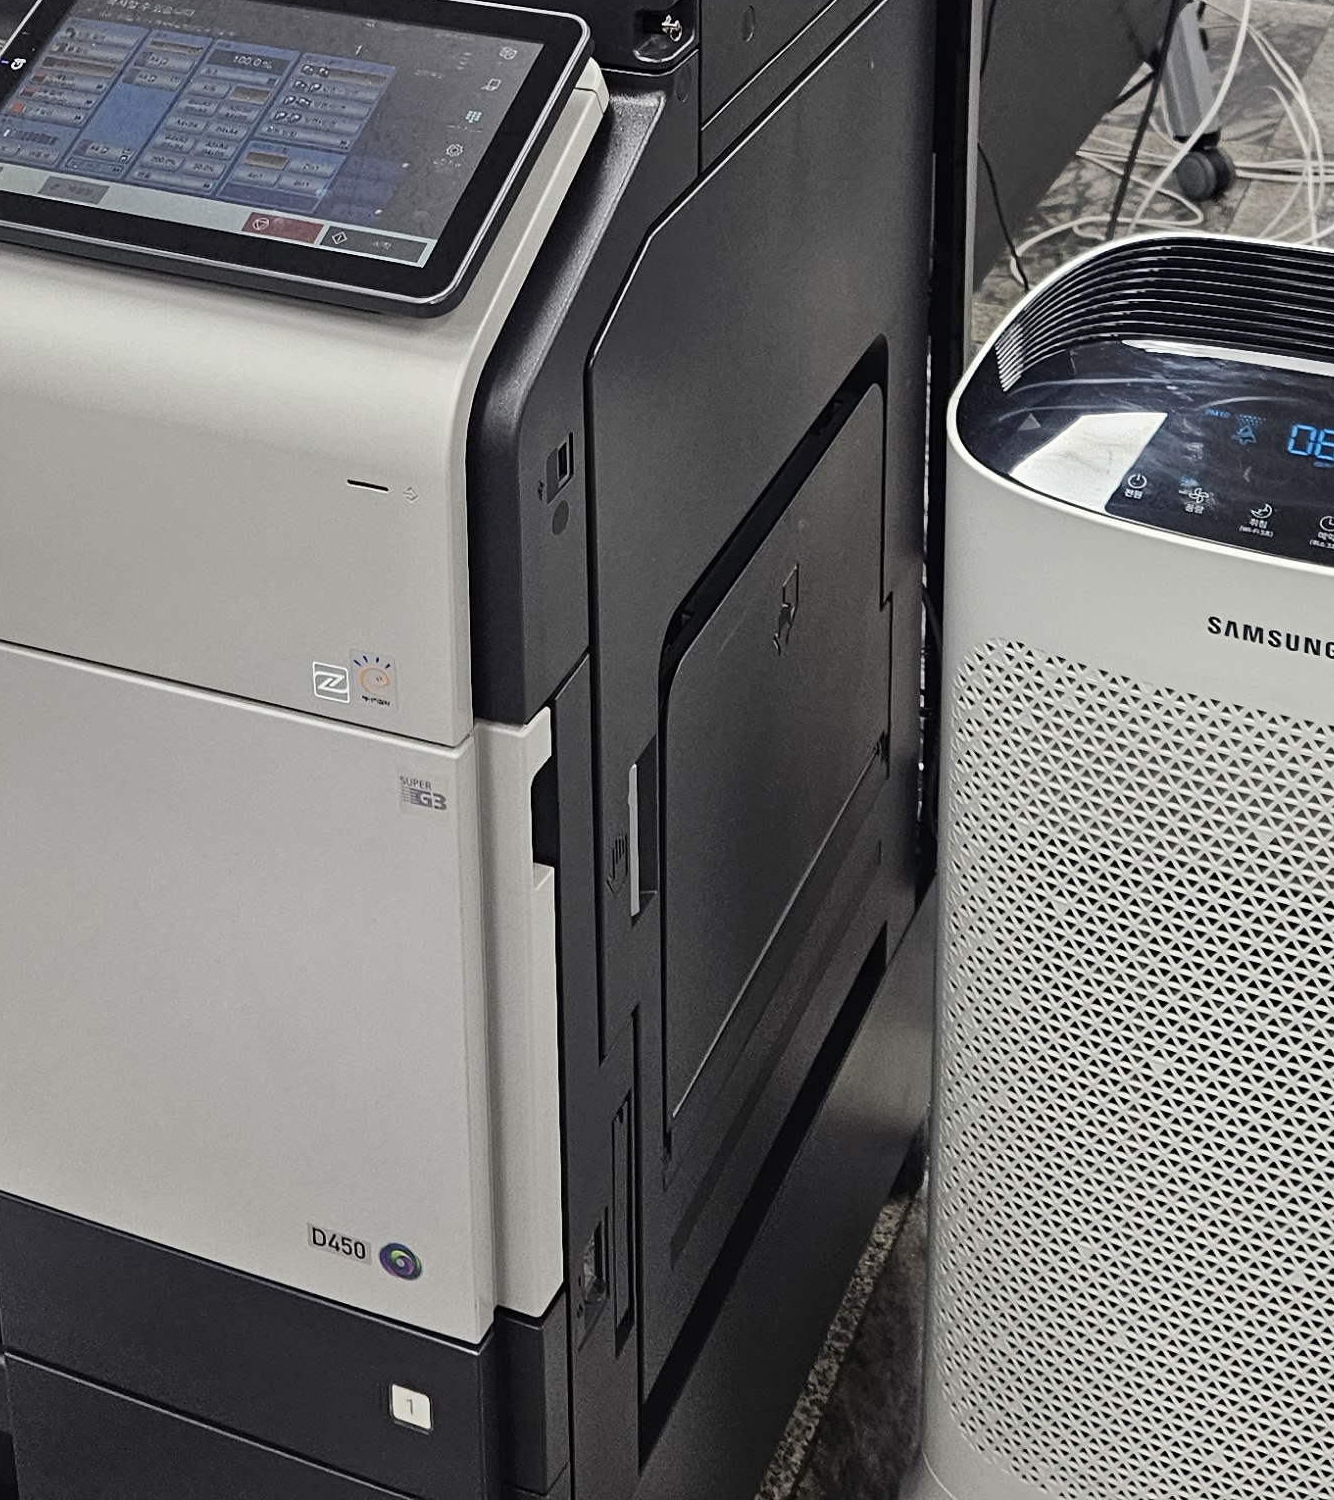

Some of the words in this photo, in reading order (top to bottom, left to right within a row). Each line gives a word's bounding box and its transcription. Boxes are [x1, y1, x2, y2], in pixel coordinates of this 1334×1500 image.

[1124, 488, 1144, 500] 전원
[1184, 503, 1205, 514] 풍량
[1248, 518, 1268, 529] 취침
[399, 776, 432, 790] SUPER
[311, 1227, 366, 1260] D450
